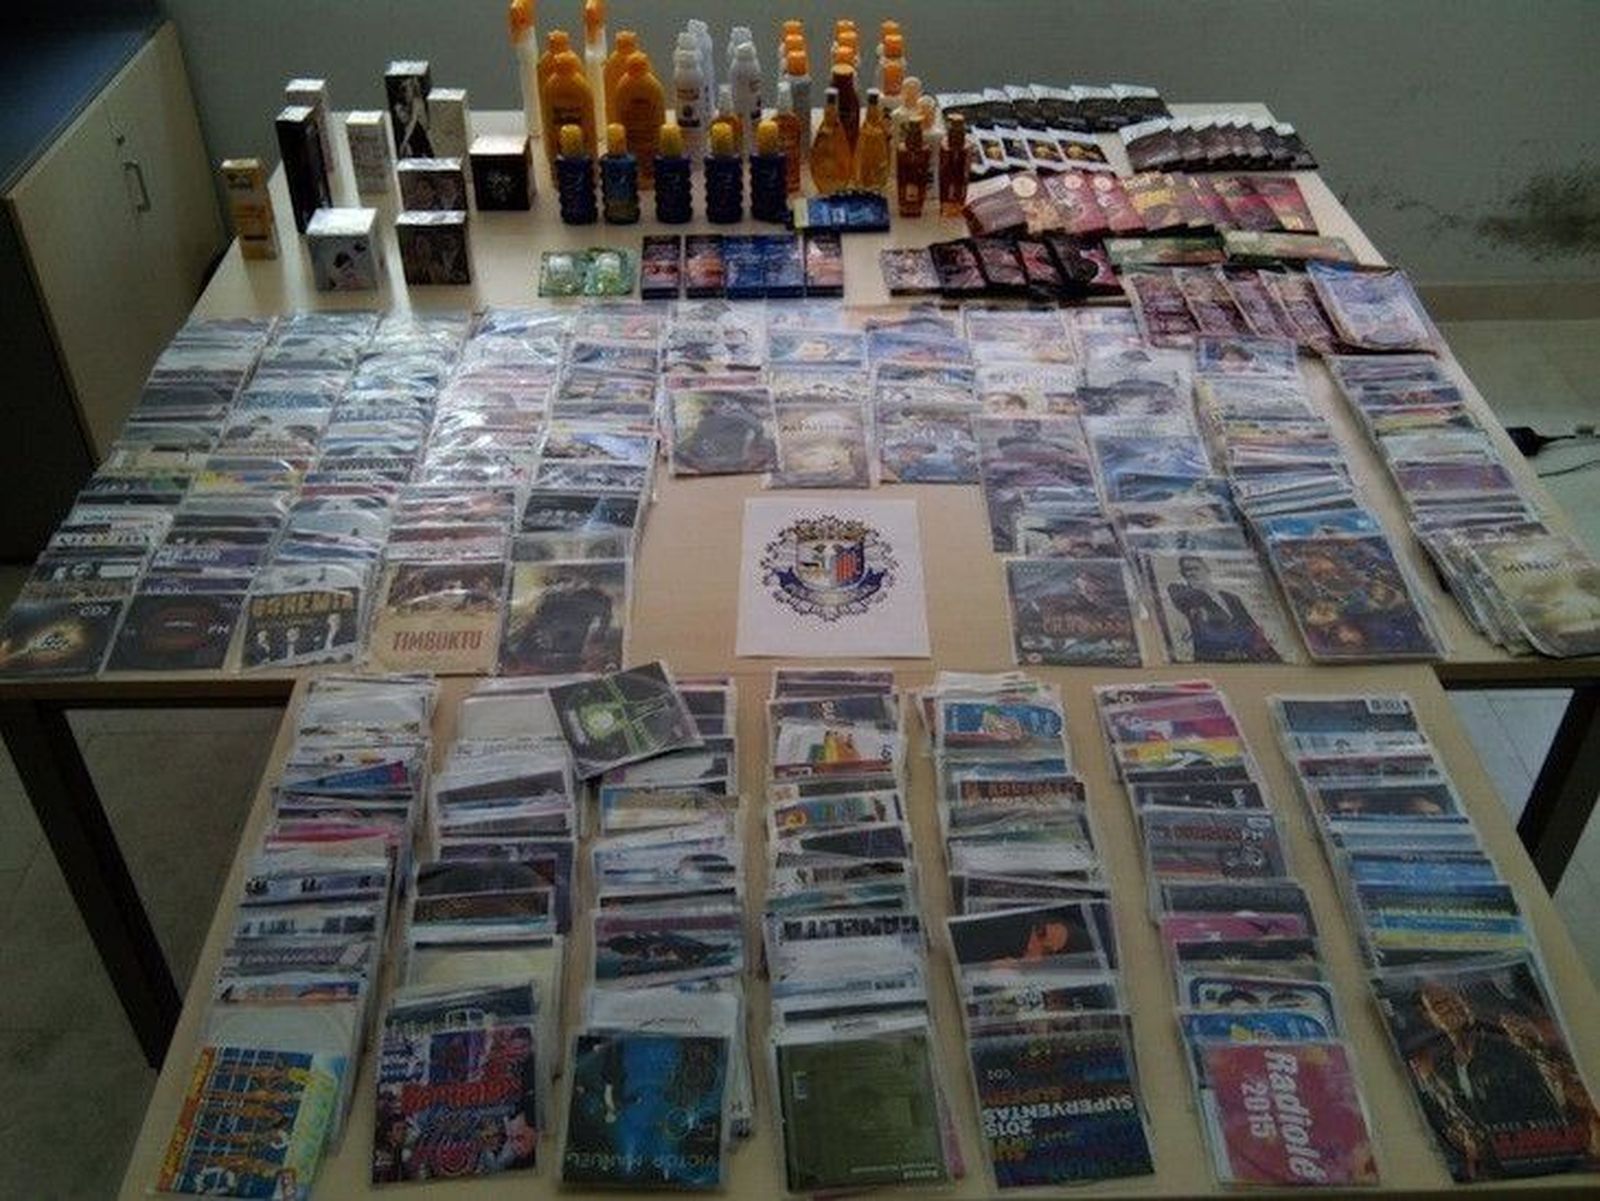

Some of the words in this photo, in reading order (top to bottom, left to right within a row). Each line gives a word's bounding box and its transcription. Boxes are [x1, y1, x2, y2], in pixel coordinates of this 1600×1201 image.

[392, 629, 483, 652] TIMBUKTU
[981, 1094, 1135, 1122] SUPERVENTAS
[1241, 1081, 1278, 1138] 2015
